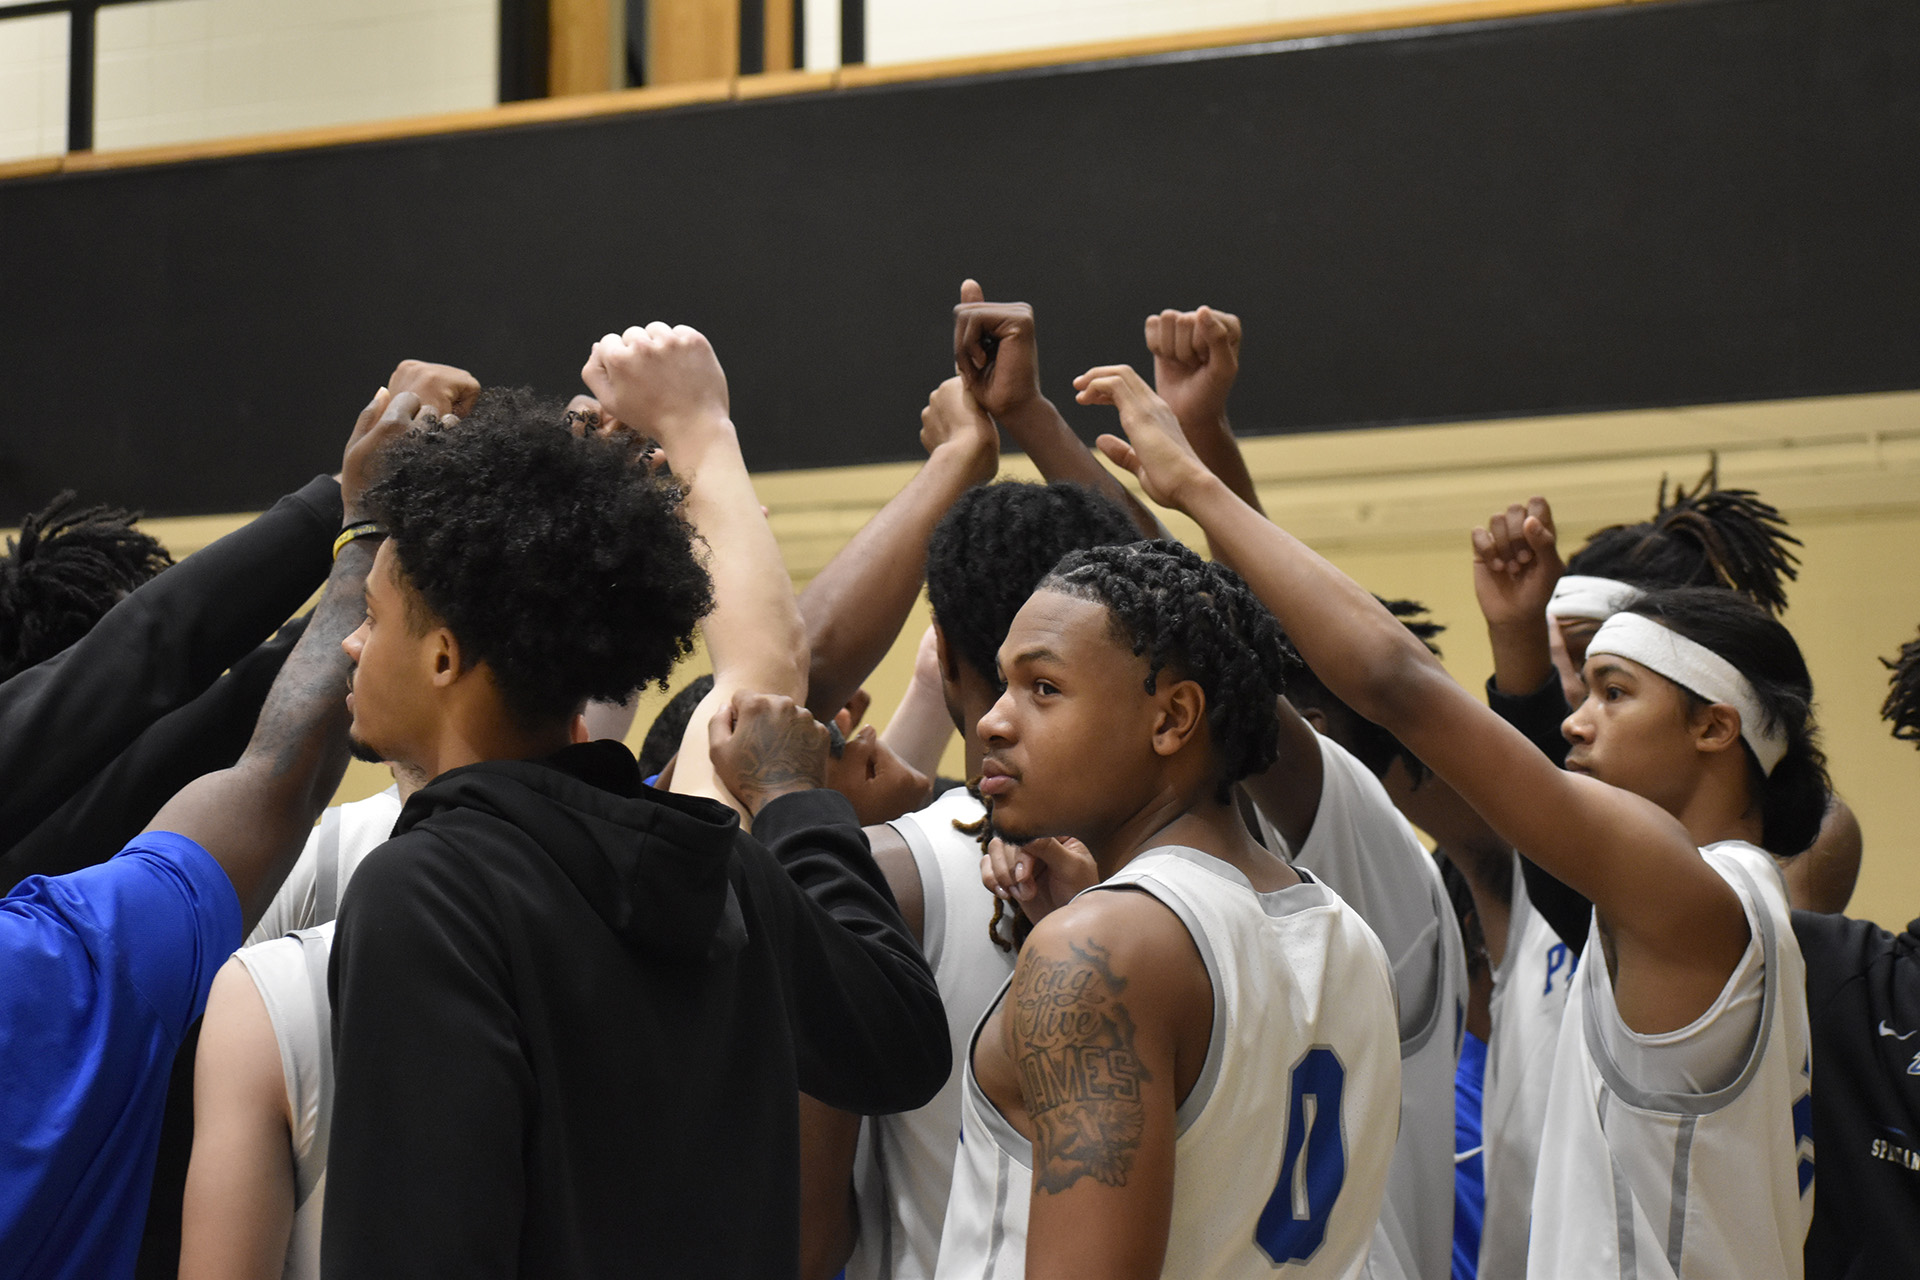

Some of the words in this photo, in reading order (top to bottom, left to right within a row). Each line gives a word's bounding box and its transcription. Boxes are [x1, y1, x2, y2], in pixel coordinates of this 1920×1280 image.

[1017, 955, 1105, 1007] Long
[1018, 994, 1099, 1050] Live
[1253, 1044, 1348, 1269] 0
